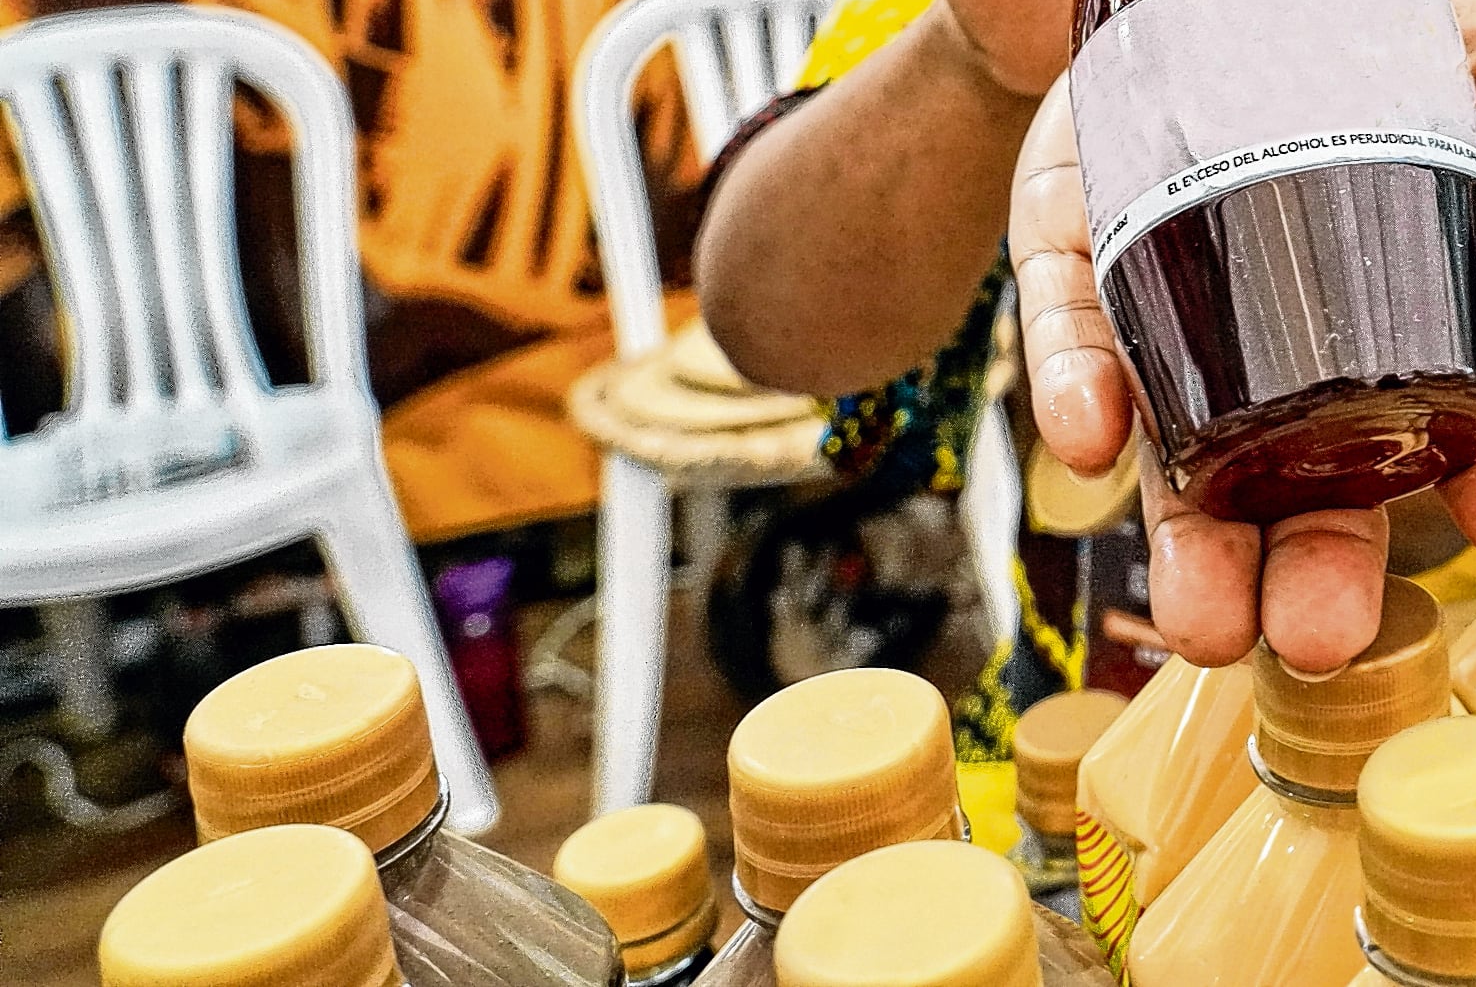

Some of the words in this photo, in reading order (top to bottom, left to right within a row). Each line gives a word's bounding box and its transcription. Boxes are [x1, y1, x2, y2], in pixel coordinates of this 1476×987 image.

[1167, 182, 1181, 196] EL
[1233, 152, 1260, 168] DEL
[1261, 137, 1329, 160] ALCOHOL
[1331, 134, 1347, 146] ES
[1349, 133, 1427, 147] PERJUDICIAL
